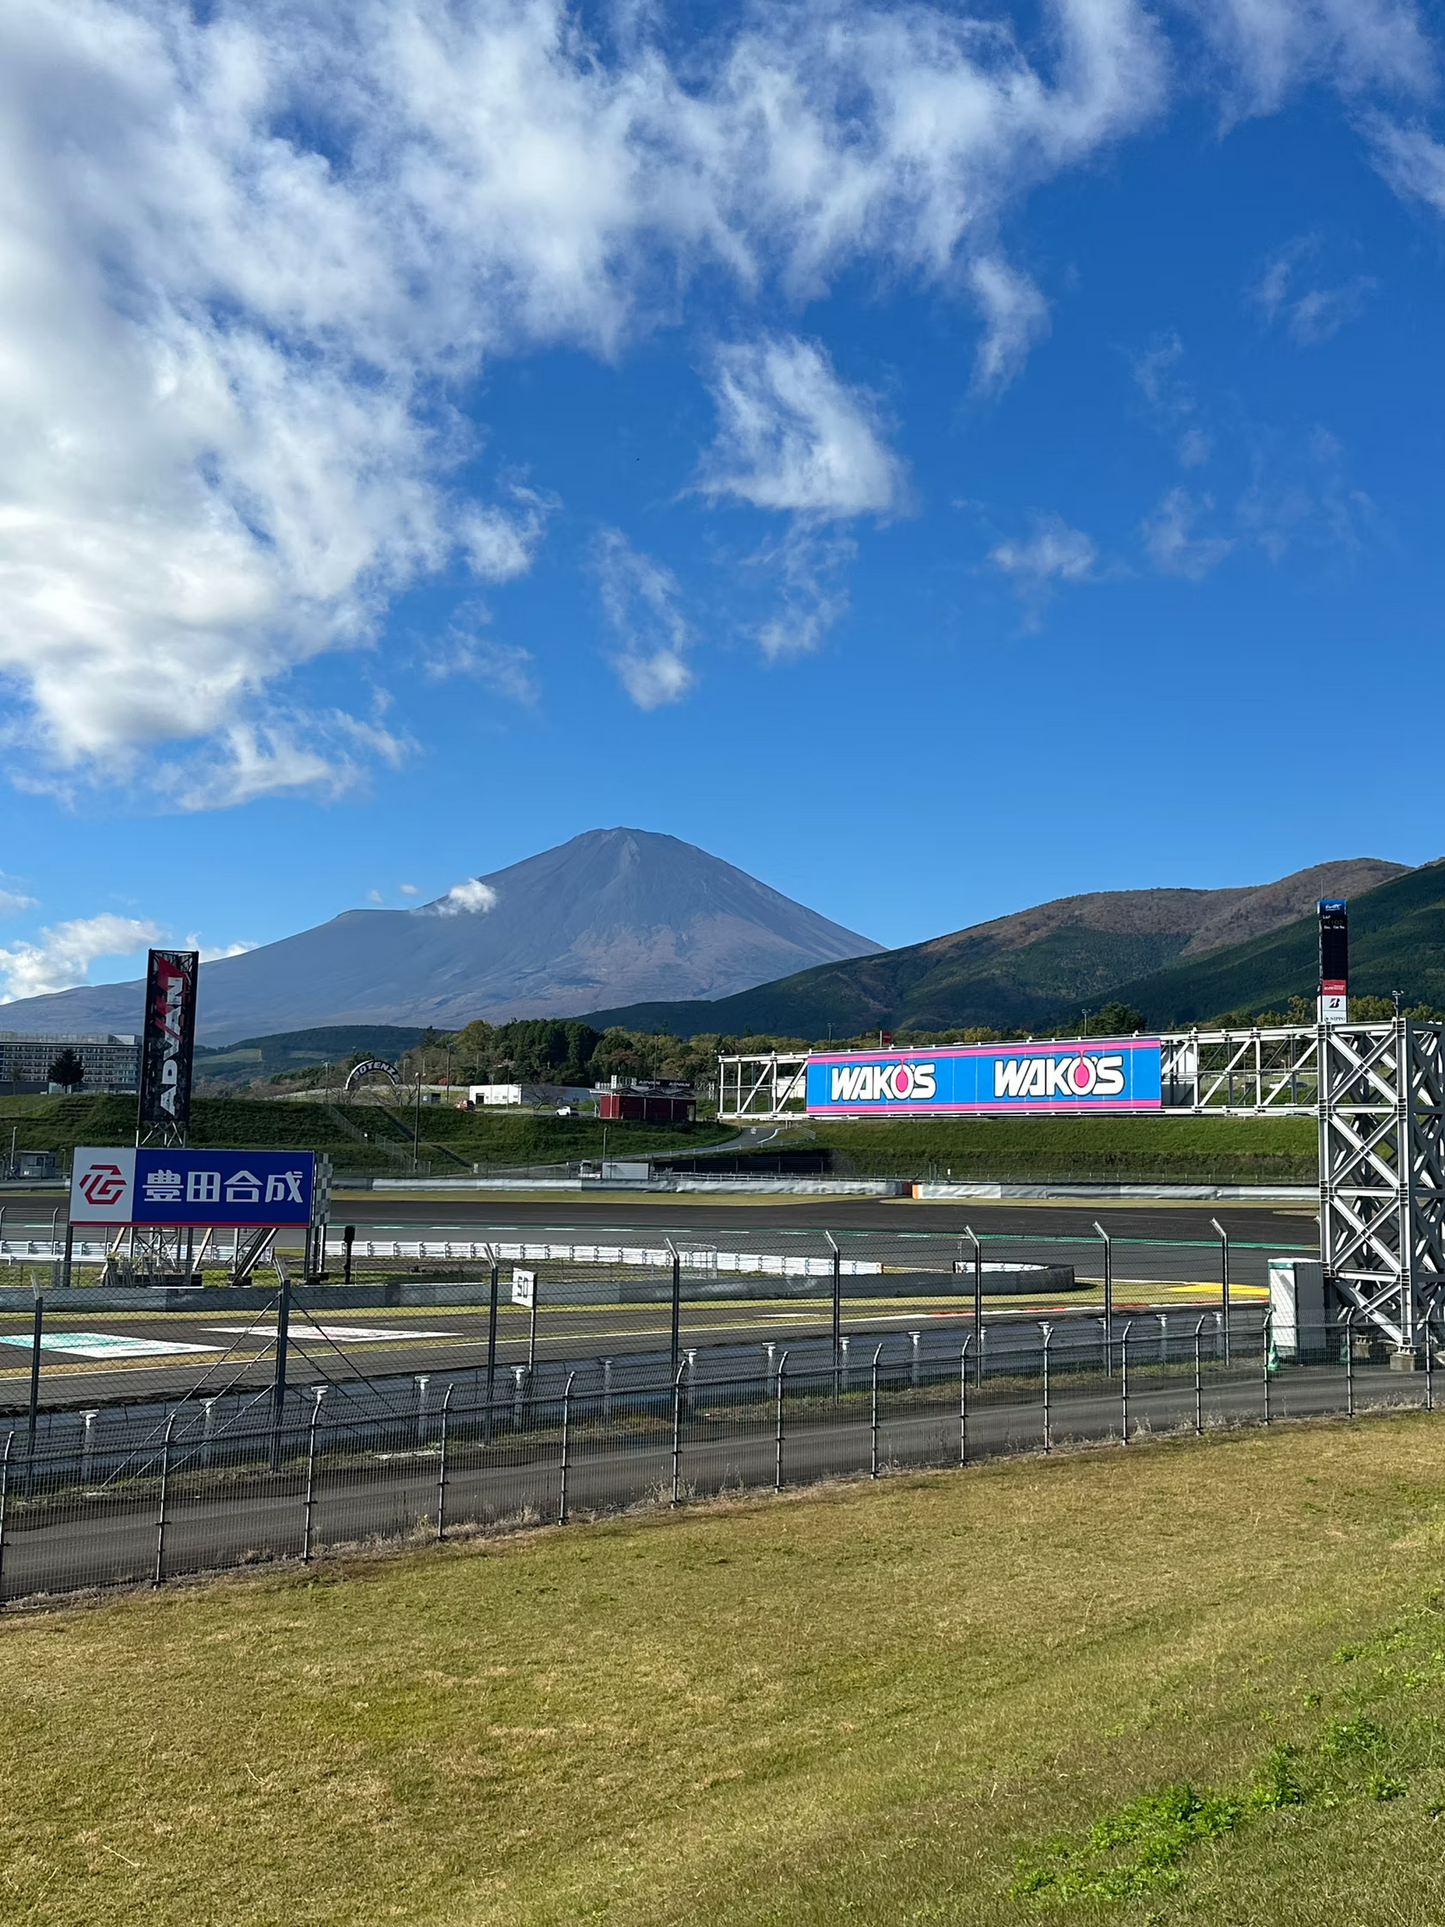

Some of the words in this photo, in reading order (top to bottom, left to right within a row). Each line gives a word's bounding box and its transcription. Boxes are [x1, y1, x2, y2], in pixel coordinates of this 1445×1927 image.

[160, 976, 184, 1117] ADVAN
[830, 1062, 936, 1101] WAKO'S
[993, 1055, 1125, 1098] WAKO'S
[142, 1169, 303, 1203] 豊田合成
